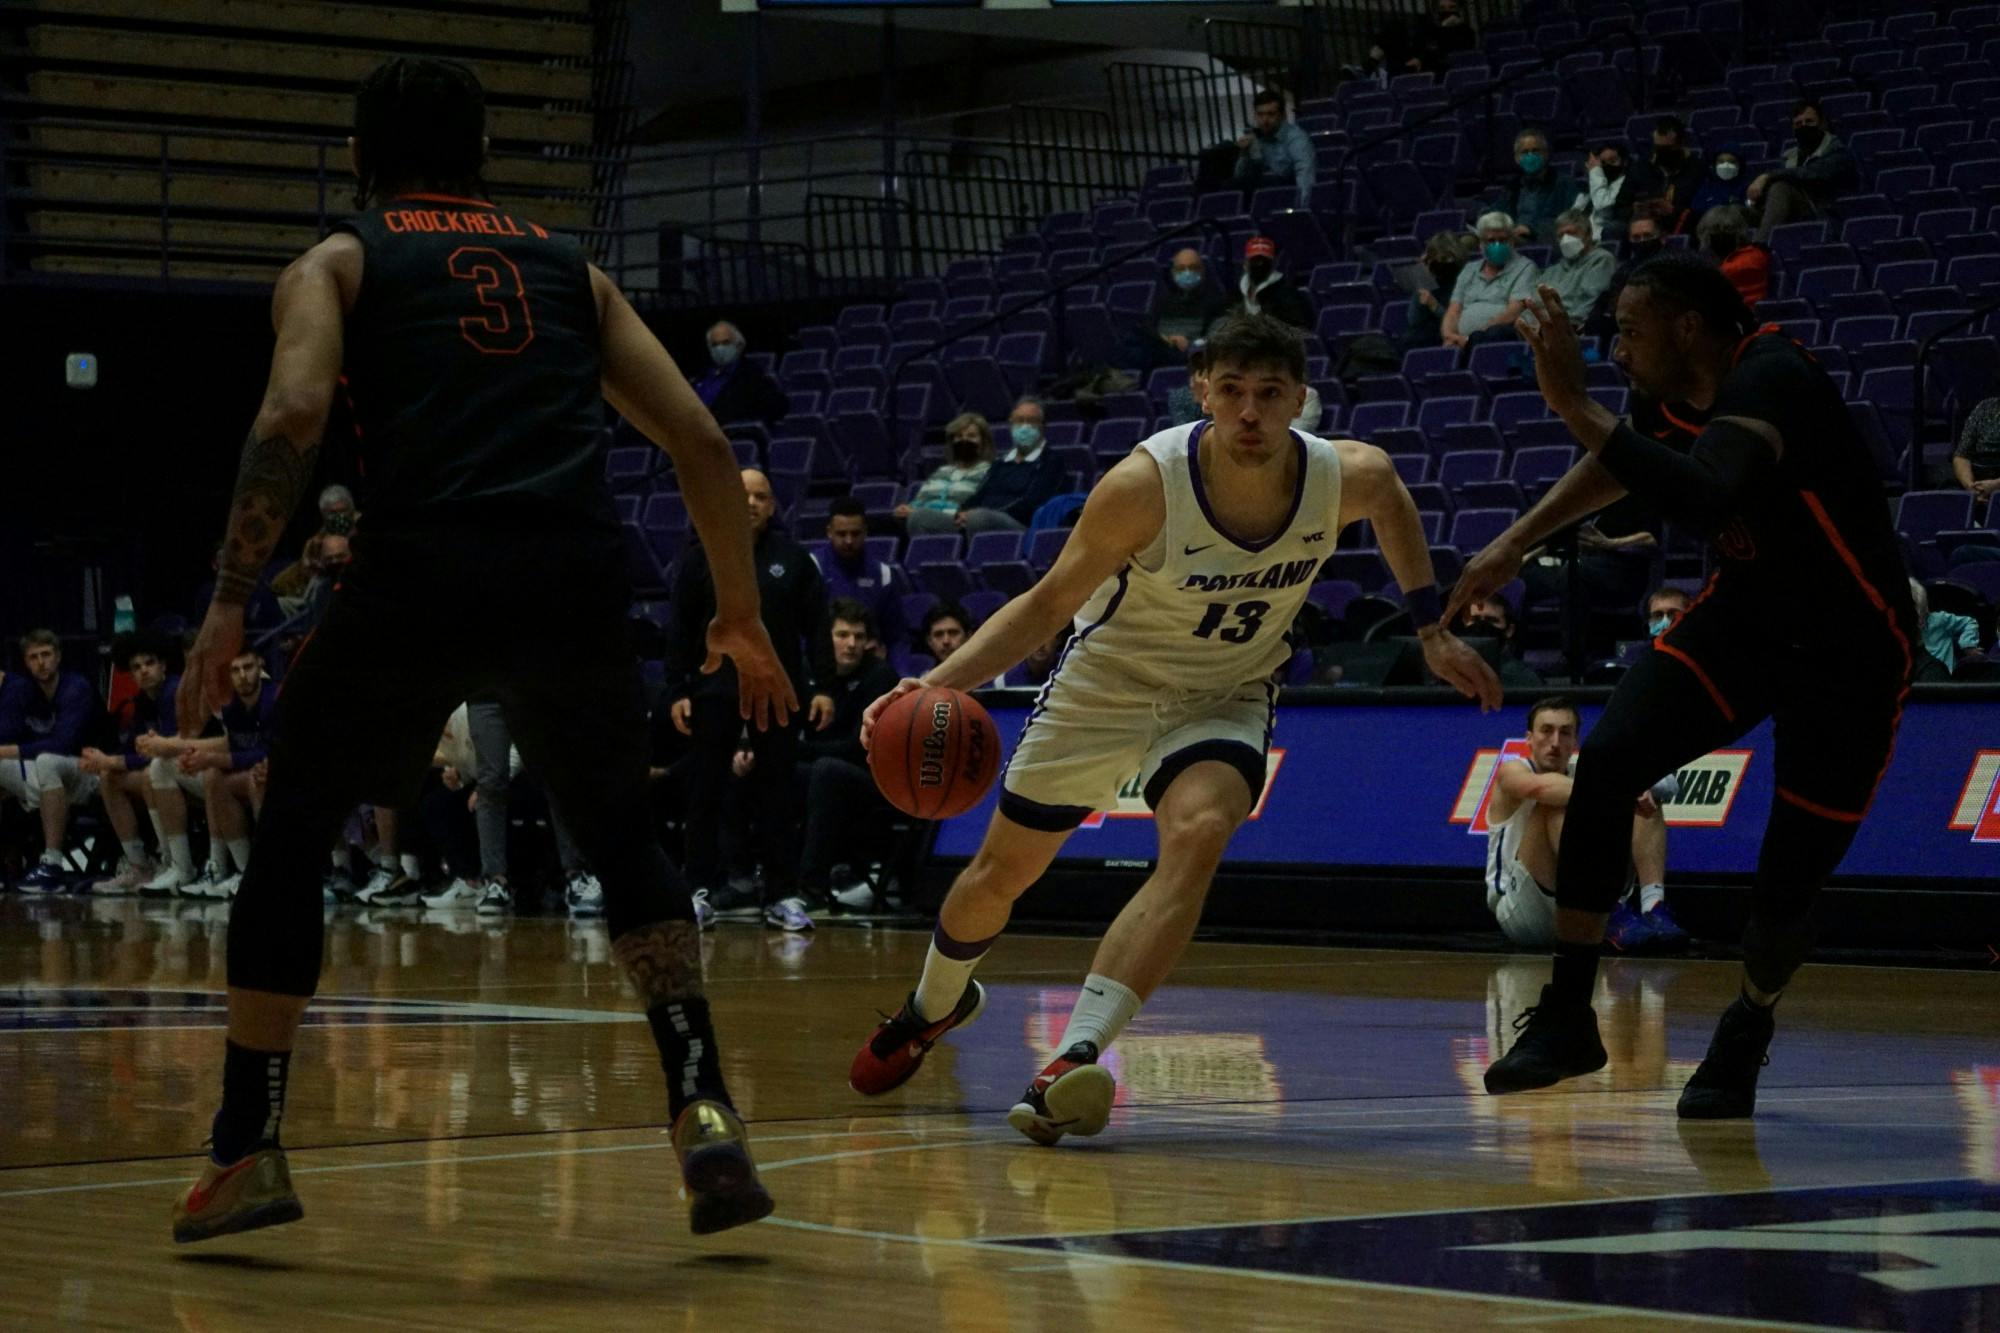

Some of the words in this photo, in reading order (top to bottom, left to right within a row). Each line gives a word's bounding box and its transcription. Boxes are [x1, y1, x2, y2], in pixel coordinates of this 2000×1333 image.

[383, 209, 526, 237] CROCKRELL
[447, 245, 535, 357] 3
[1192, 600, 1271, 643] 13
[919, 702, 951, 789] Wilson
[1661, 770, 1731, 805] WAB
